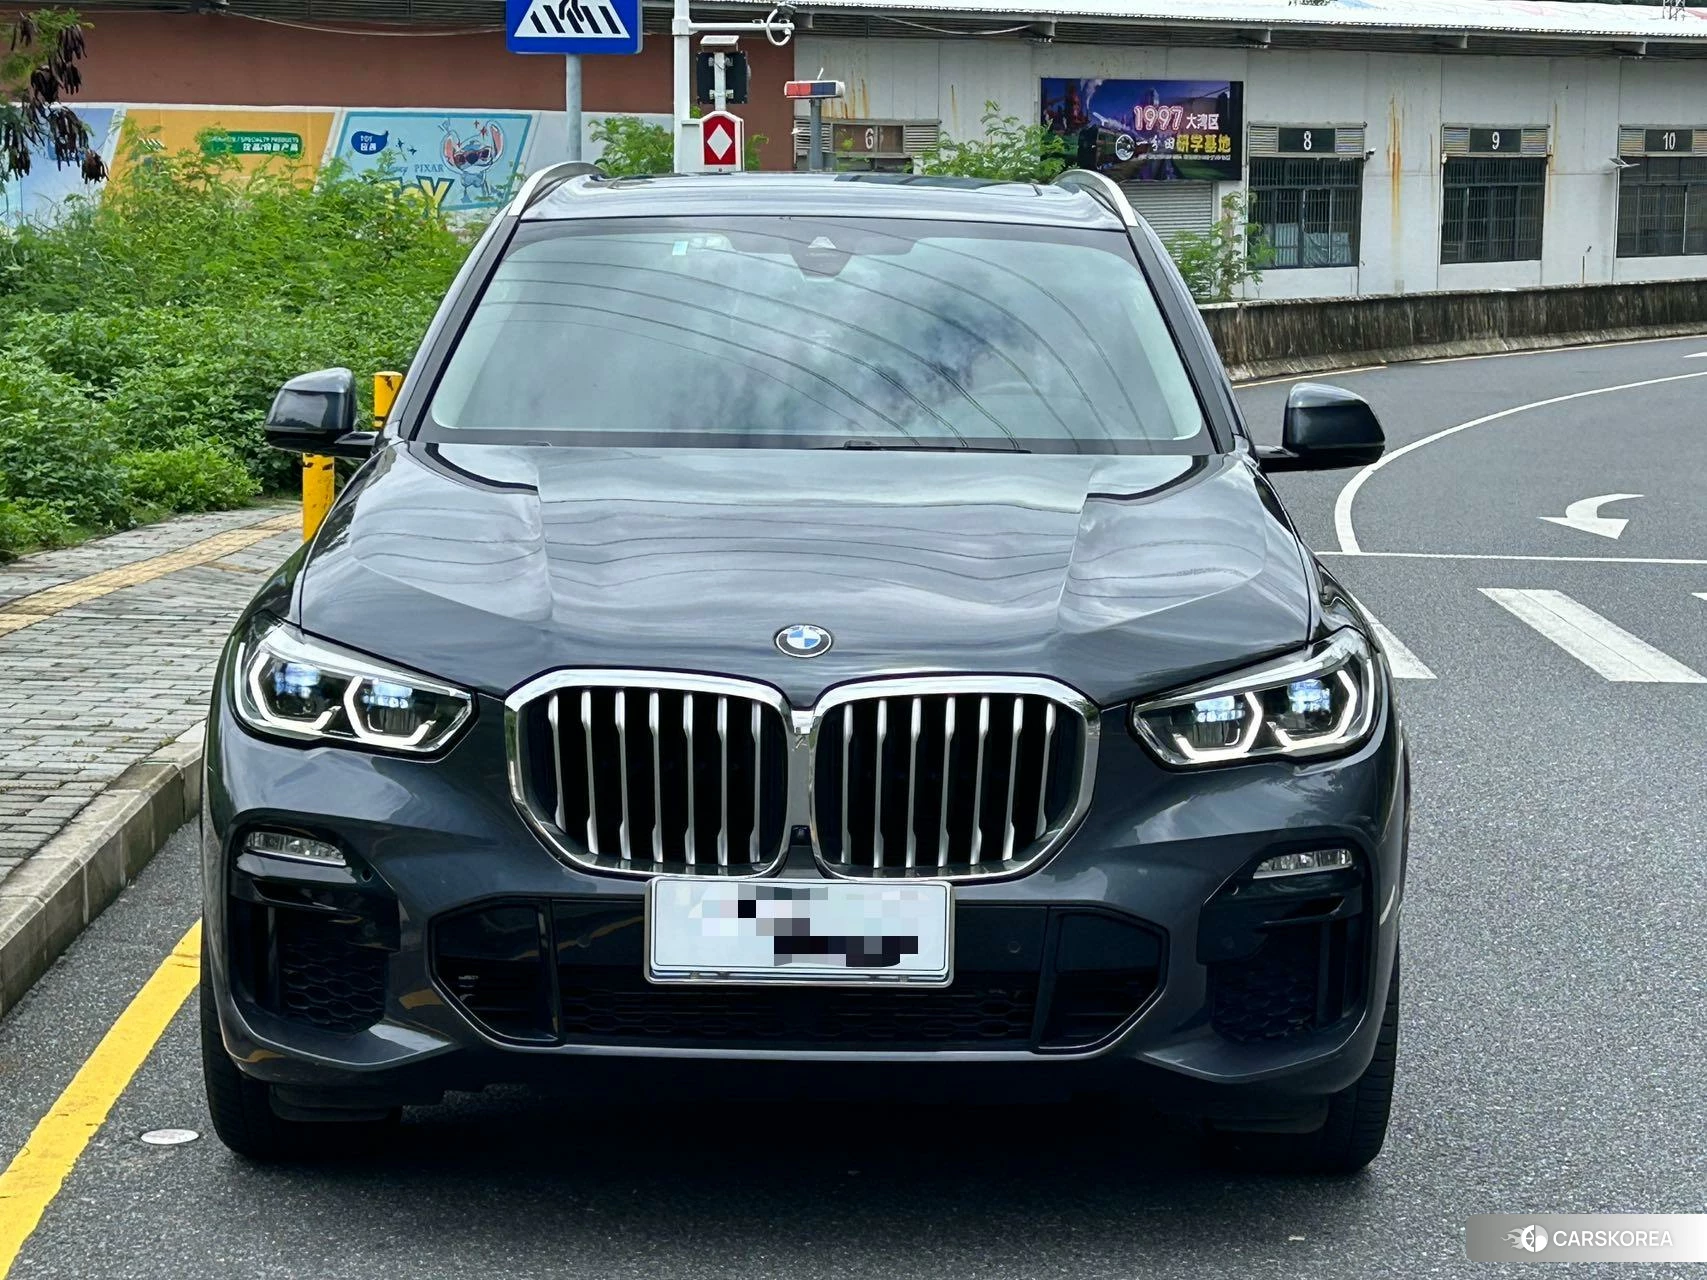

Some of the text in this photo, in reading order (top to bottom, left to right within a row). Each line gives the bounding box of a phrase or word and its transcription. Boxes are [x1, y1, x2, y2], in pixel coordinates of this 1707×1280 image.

[1133, 105, 1219, 131] 1997 大湾区
[865, 127, 874, 150] 6
[1303, 130, 1312, 151] 8
[1492, 131, 1500, 150] 9
[1662, 131, 1676, 151] 10
[415, 163, 445, 173] PIXAR
